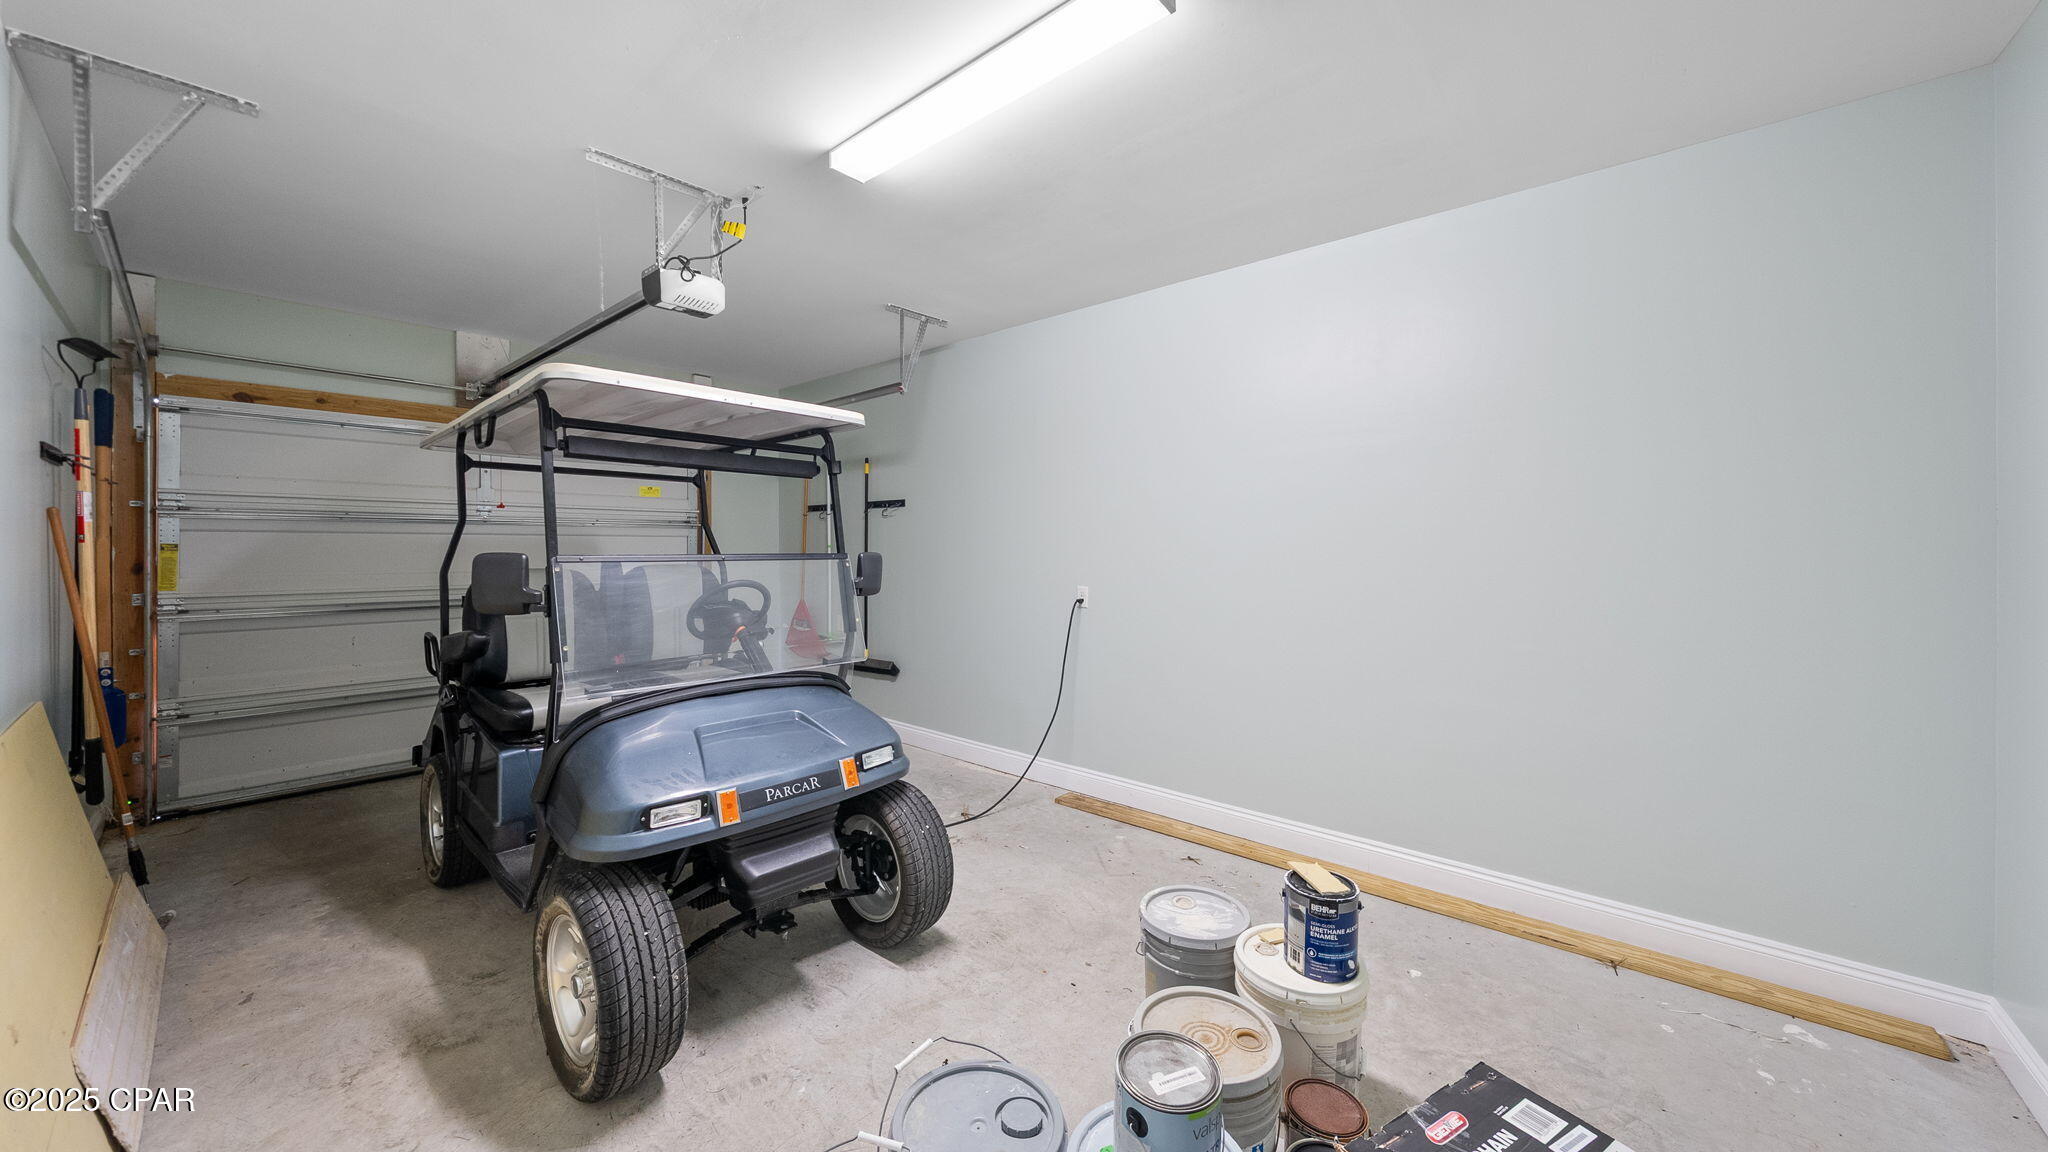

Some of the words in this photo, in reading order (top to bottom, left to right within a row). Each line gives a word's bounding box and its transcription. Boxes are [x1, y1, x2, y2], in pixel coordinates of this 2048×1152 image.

[765, 777, 821, 802] PARCAR
[1311, 903, 1329, 913] BEHR
[1310, 925, 1345, 935] URETHANE
[1310, 931, 1338, 941] ENAMEL
[1431, 1115, 1464, 1141] GENIE
[1471, 1128, 1519, 1152] HAIN
